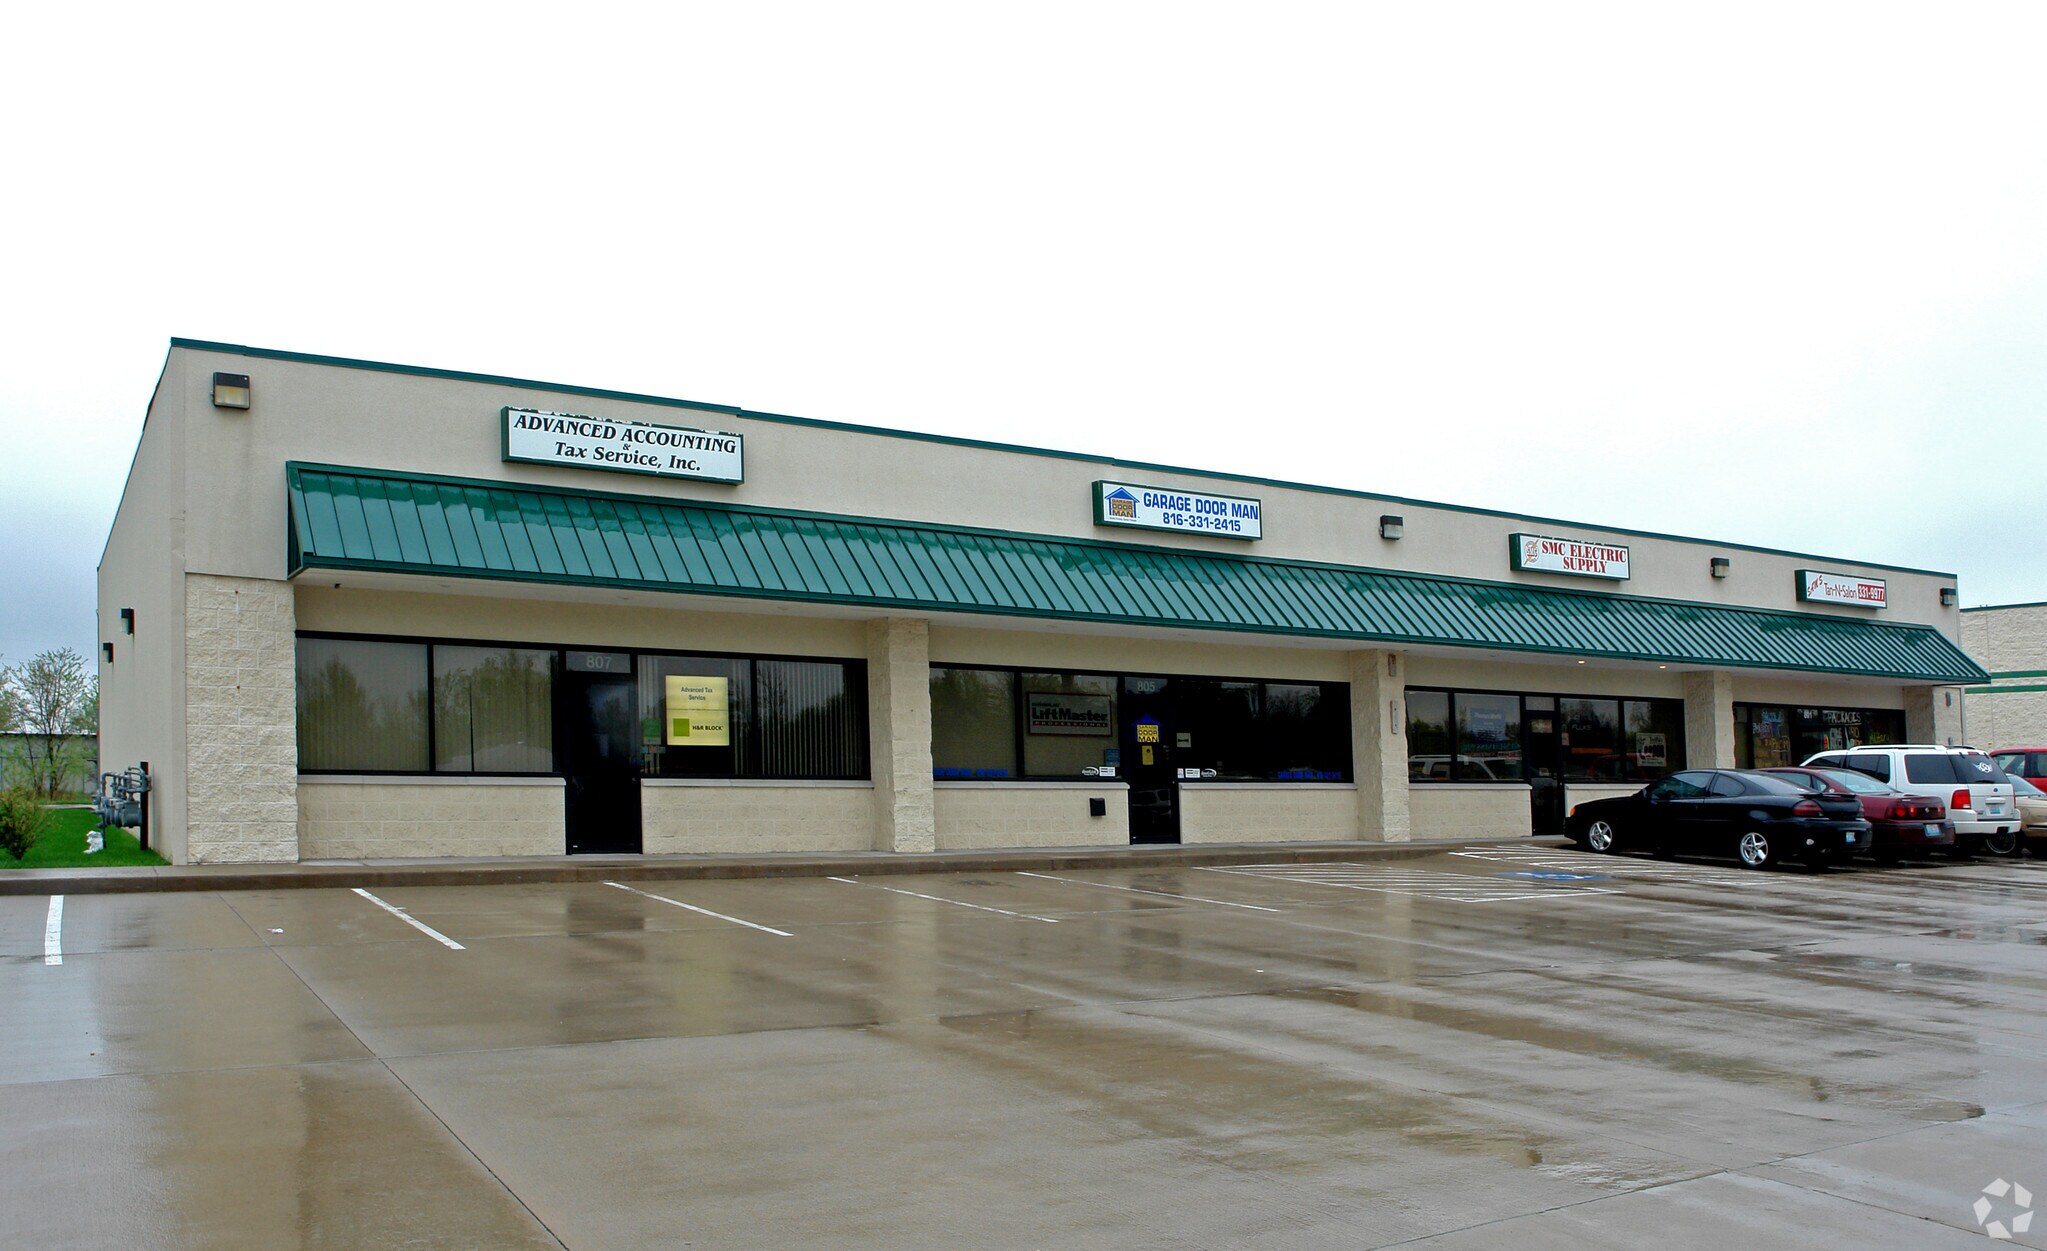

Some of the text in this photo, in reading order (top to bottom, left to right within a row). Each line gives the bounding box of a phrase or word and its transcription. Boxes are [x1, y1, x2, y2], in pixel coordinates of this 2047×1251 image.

[514, 414, 737, 454] ADVANCED ACCOUNTING
[622, 442, 631, 451] &
[555, 441, 701, 471] Tax Service, Inc.
[1112, 510, 1133, 518] MAN
[1143, 492, 1259, 520] GARAGE DOOR MAN
[1163, 512, 1241, 532] 816-331-2415
[1541, 540, 1626, 563] SMC ELECTRIC
[1563, 557, 1608, 574] SUPPLY
[586, 655, 613, 669] 807
[680, 686, 704, 694] Advanced
[1137, 680, 1156, 692] 805
[1031, 706, 1109, 722] LiftMaster
